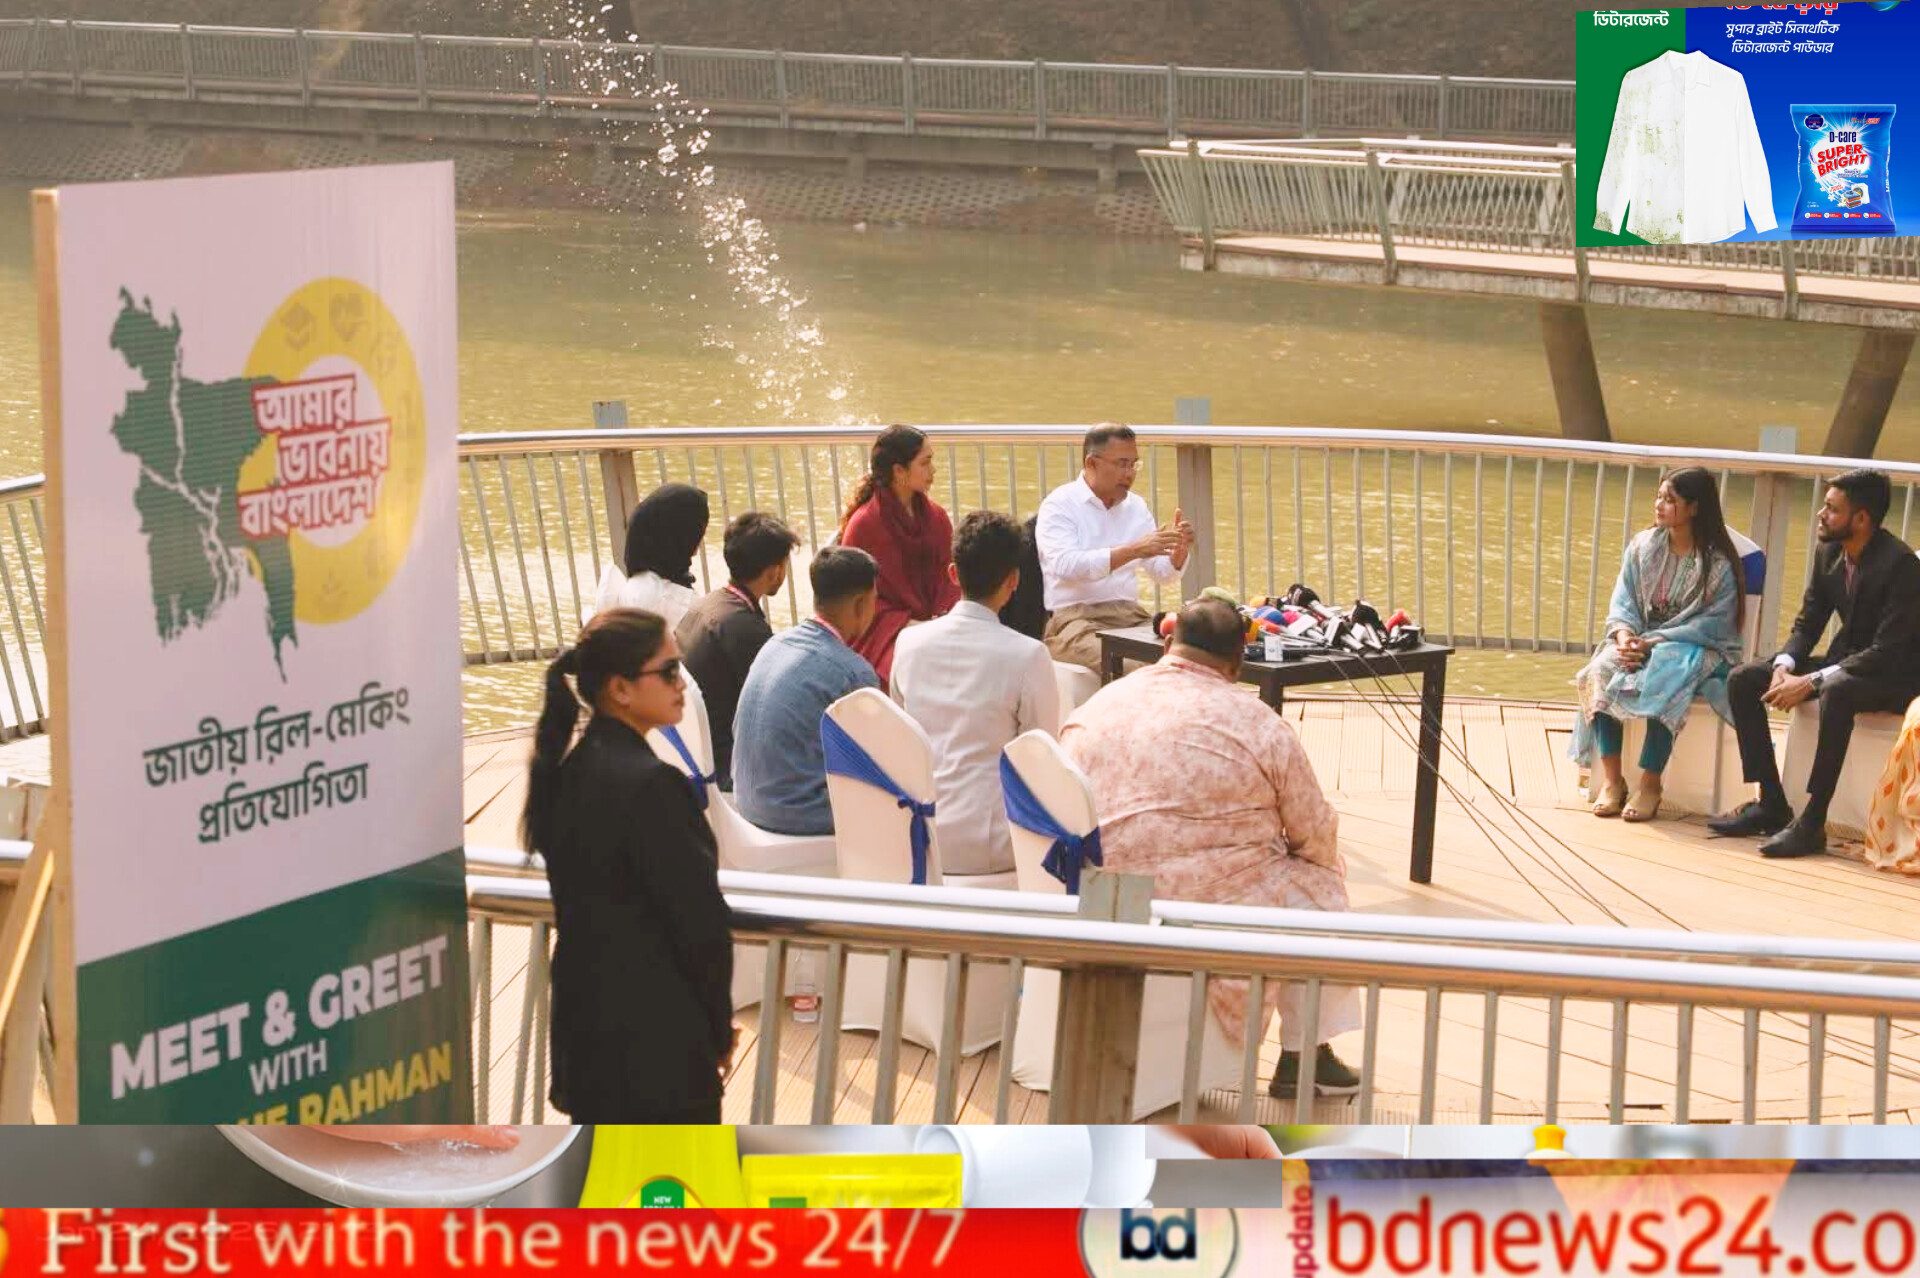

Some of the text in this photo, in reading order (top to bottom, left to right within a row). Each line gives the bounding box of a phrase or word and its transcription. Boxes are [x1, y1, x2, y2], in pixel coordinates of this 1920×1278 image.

[1817, 144, 1863, 163] SUPER
[1817, 154, 1868, 177] BRIGHT
[254, 374, 356, 432] আমার
[279, 417, 391, 482] ভাবনায়
[237, 475, 375, 540] বাংলাদেশ
[142, 681, 411, 787] জাতীয় রিল-মেকিং
[198, 761, 369, 843] প্রতিযোগিতা
[111, 935, 448, 1099] MEET & GREET
[249, 1038, 327, 1095] WITH
[299, 1041, 453, 1125] RAHMAN
